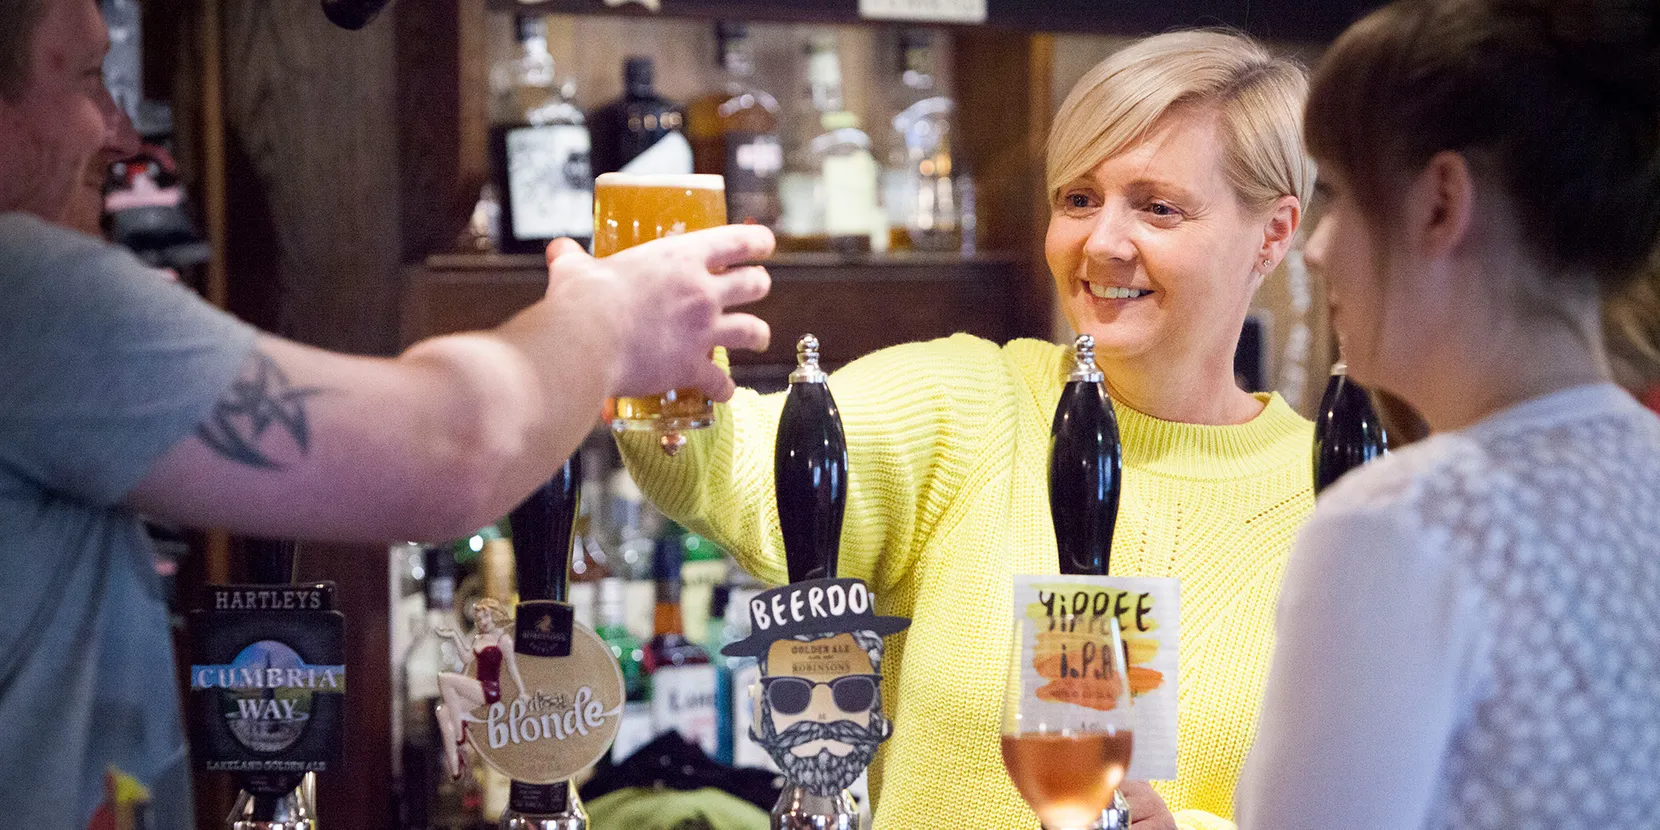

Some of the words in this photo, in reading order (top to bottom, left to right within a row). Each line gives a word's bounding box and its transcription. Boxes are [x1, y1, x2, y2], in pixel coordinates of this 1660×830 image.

[215, 591, 321, 610] HARTLEYS
[751, 582, 868, 630] BEERDO
[791, 645, 829, 654] GOLDEN
[832, 644, 850, 653] ALE
[792, 661, 850, 673] ROBINSONS
[200, 668, 337, 688] CUMBRIA
[237, 700, 298, 719] WAY
[487, 686, 604, 749] blonde
[206, 761, 262, 771] LAKELAND
[263, 761, 304, 771] GOLDEN
[306, 761, 326, 771] ALE
